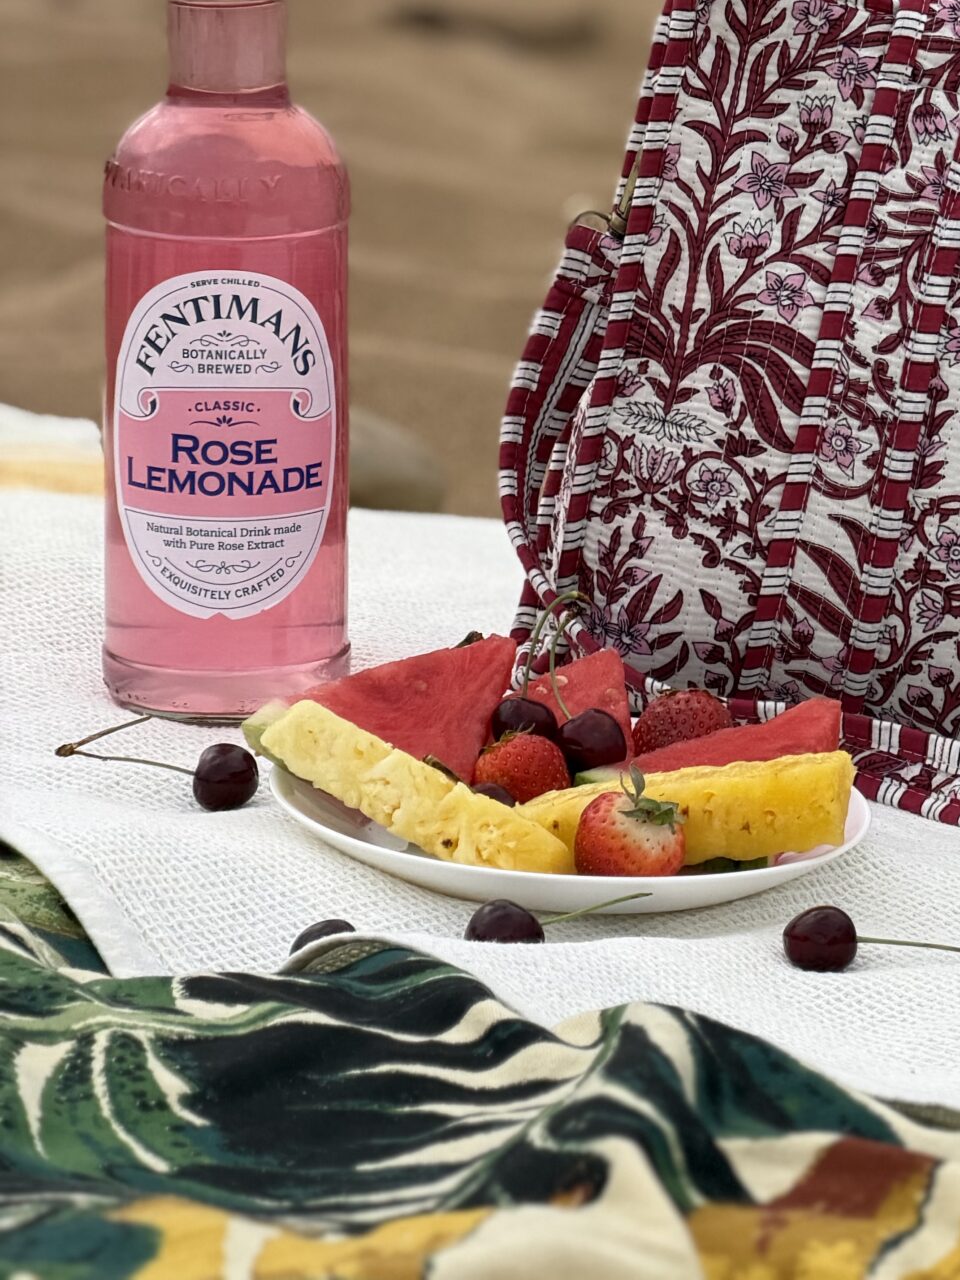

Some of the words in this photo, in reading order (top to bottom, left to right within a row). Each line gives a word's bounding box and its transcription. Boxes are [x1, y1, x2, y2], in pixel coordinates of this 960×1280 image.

[190, 278, 219, 289] SERVE
[221, 278, 260, 288] CHILLED
[136, 294, 316, 376] FENTIMANS
[182, 348, 267, 360] BOTANICALLY
[197, 363, 251, 375] BREWED
[195, 401, 255, 412] CLASSIC
[146, 522, 183, 536] Natural
[186, 526, 237, 538] Botanical
[240, 527, 271, 537] Drink
[274, 523, 302, 535] made
[163, 538, 187, 550] with
[189, 540, 215, 551] Pure
[218, 541, 245, 551] Rose
[247, 538, 285, 550] Extract
[160, 566, 231, 600] EXQUISITELY
[234, 567, 285, 598] CRAFTED
